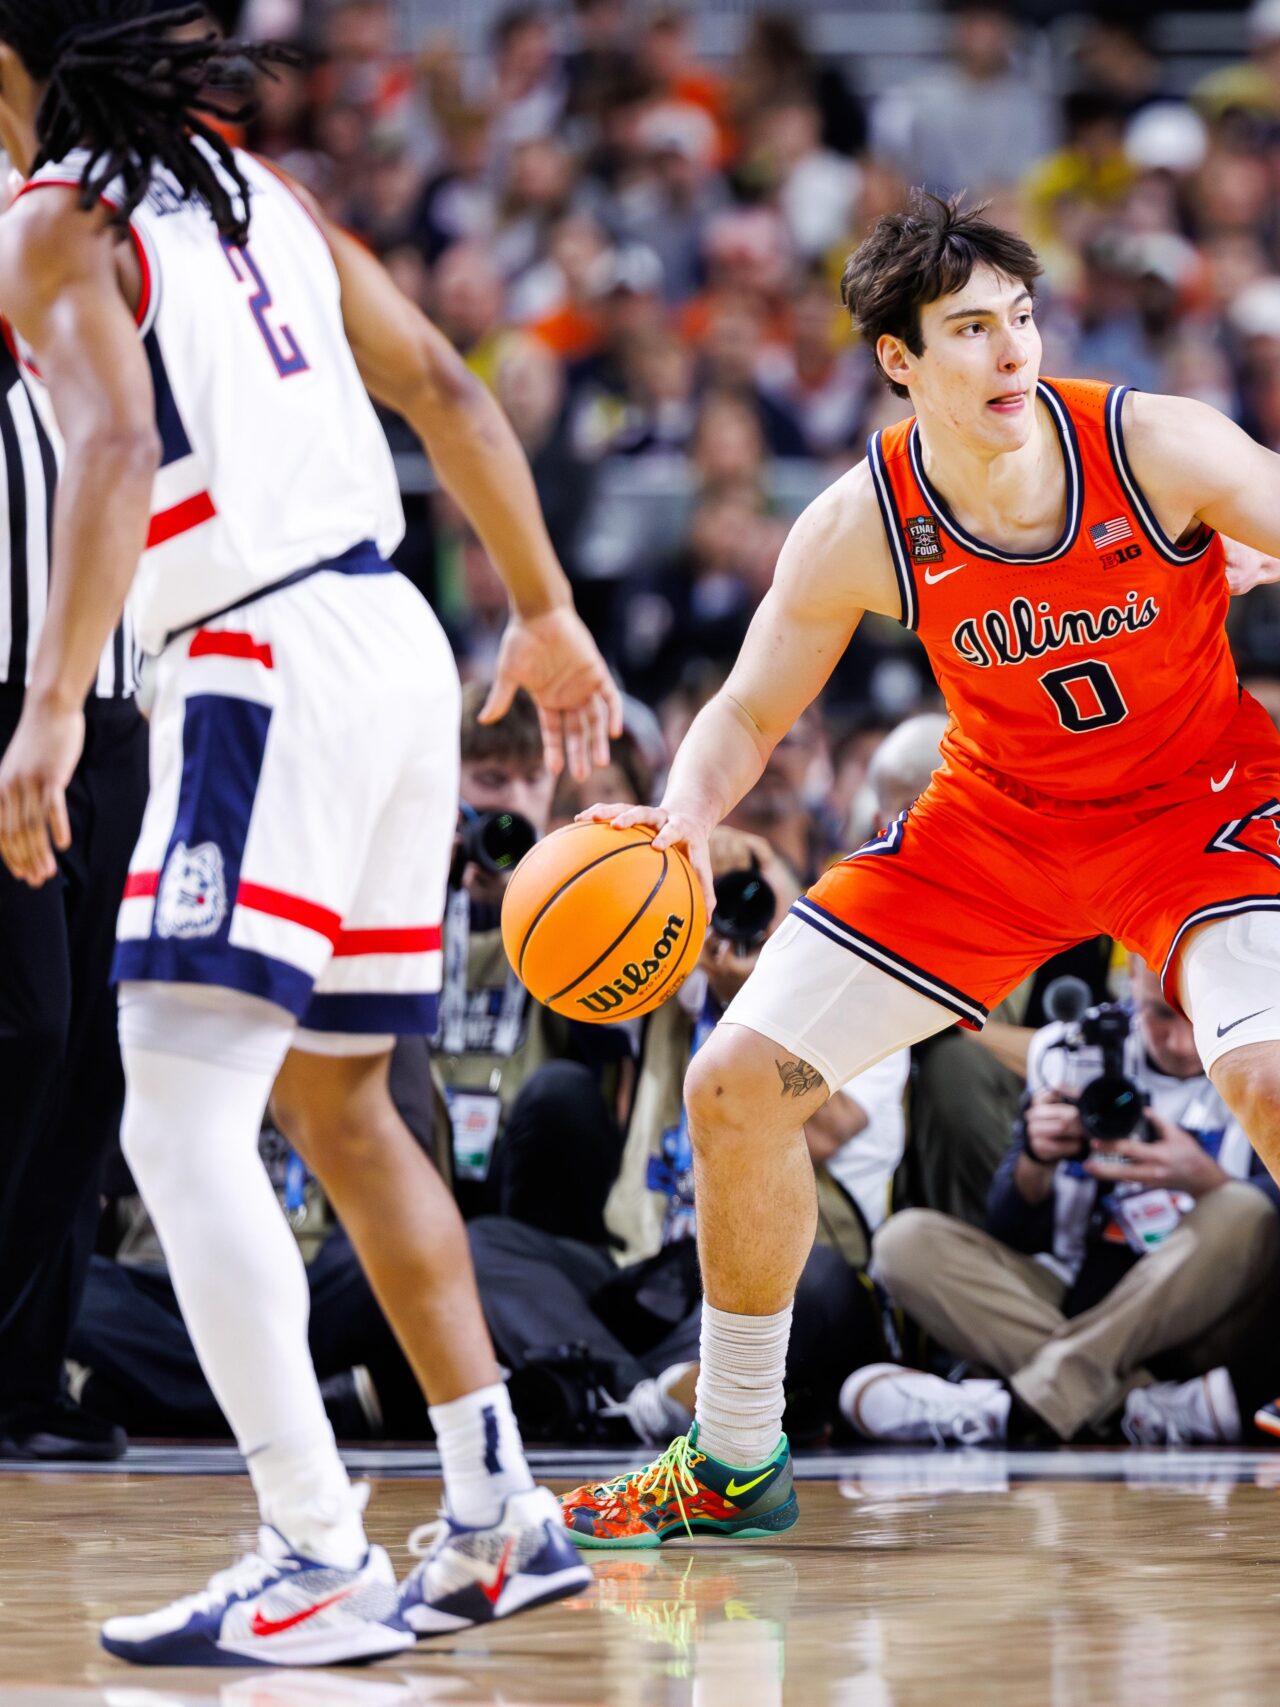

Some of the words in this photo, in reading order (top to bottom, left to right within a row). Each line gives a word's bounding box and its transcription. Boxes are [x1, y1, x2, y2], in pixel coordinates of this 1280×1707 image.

[217, 231, 309, 379] 2
[910, 524, 935, 537] FINAL
[915, 544, 939, 556] FOUR
[952, 591, 1160, 667] Illinois
[1038, 658, 1129, 734] 0
[576, 913, 685, 1013] Wilson
